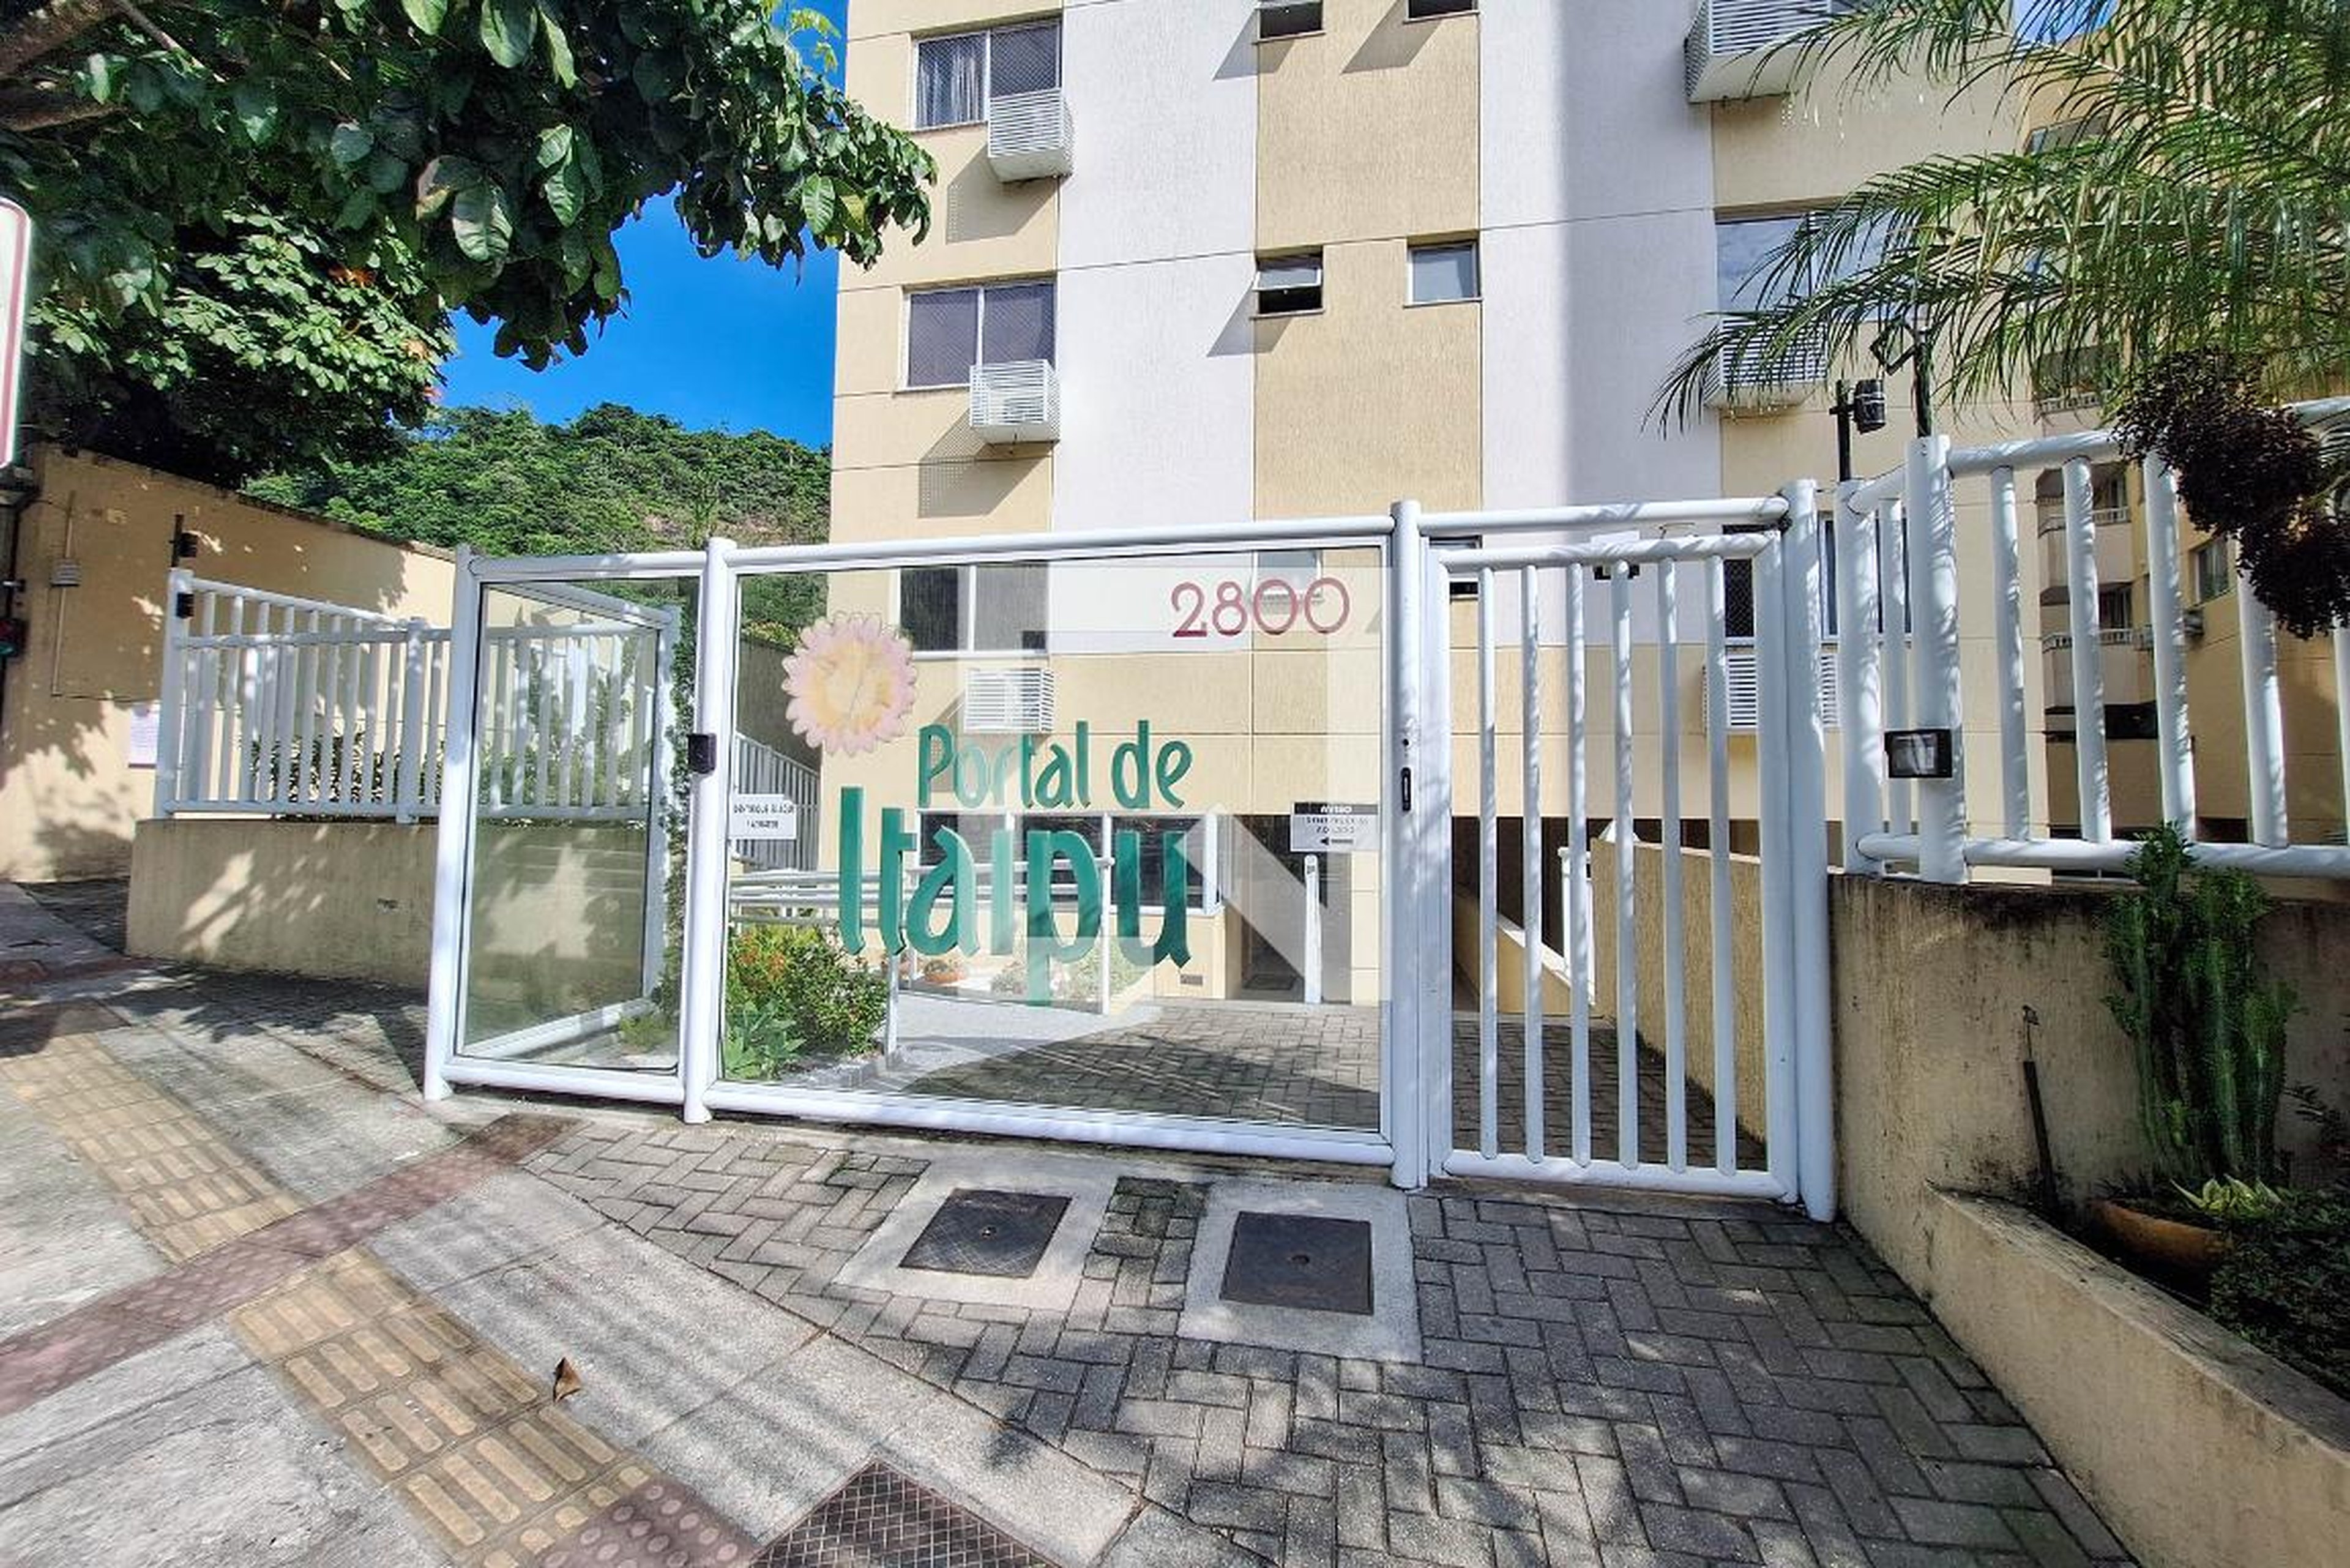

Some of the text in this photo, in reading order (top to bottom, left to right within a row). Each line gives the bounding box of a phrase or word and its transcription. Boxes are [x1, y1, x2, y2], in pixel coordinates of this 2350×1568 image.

[1171, 577, 1350, 637] 2800
[918, 719, 1193, 809] Portal de
[838, 786, 1192, 1007] Itaipu
